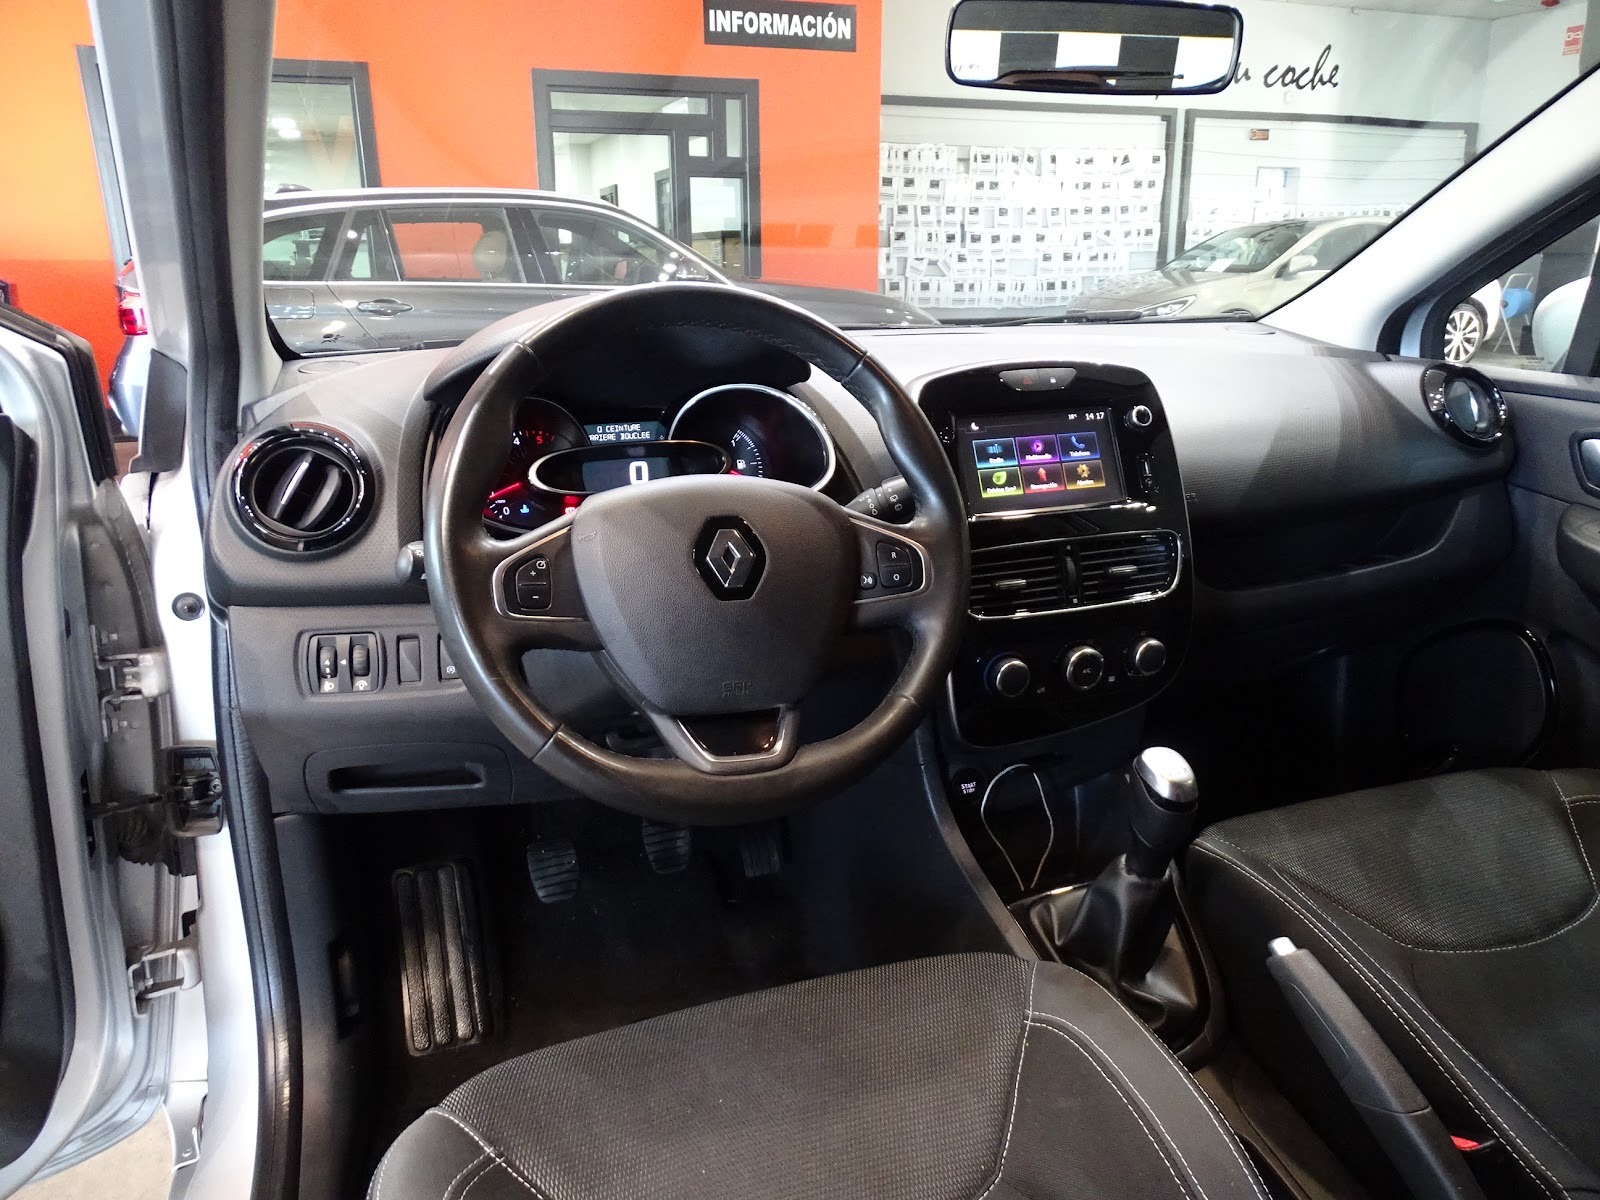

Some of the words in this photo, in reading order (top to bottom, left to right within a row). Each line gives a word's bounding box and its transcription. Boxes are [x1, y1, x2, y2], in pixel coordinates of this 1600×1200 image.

[708, 9, 851, 40] INFORMACIÓN
[1263, 44, 1339, 91] coche
[605, 423, 641, 433] CEINTURE
[512, 436, 521, 446] 4
[536, 435, 543, 445] 5
[629, 460, 649, 485] 0
[502, 506, 511, 516] 0
[891, 551, 897, 559] R
[960, 781, 977, 790] START
[962, 787, 976, 795] STOP
